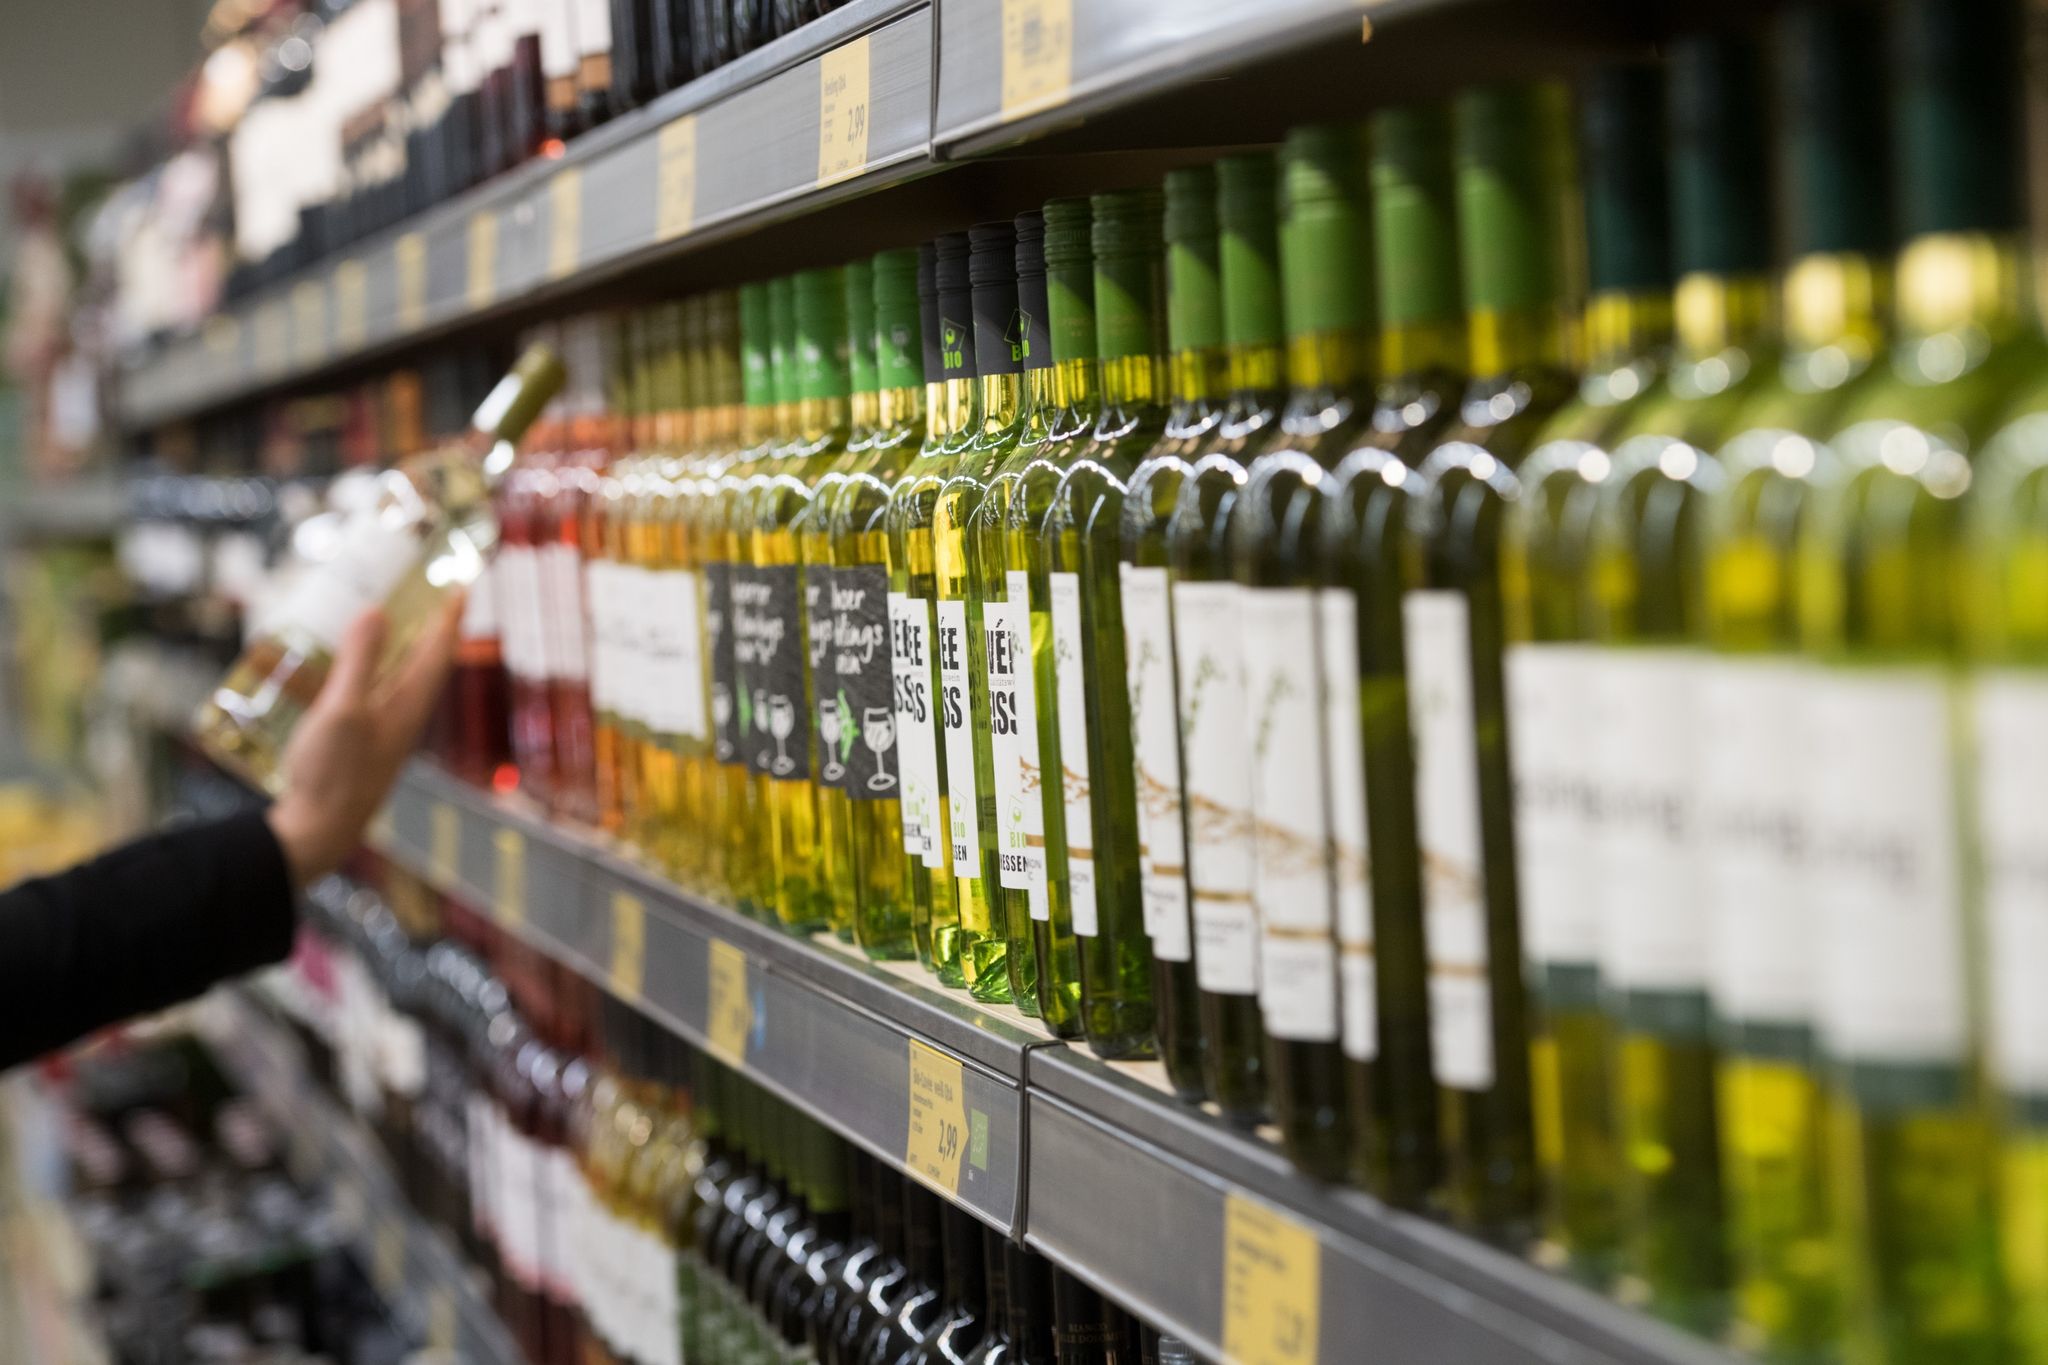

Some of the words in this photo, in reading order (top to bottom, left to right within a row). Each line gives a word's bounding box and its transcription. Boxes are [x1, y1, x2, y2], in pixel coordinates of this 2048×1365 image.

[847, 103, 865, 147] 2,99
[943, 350, 963, 370] BIO
[989, 690, 1018, 735] ISS
[938, 1119, 958, 1162] 2,99
